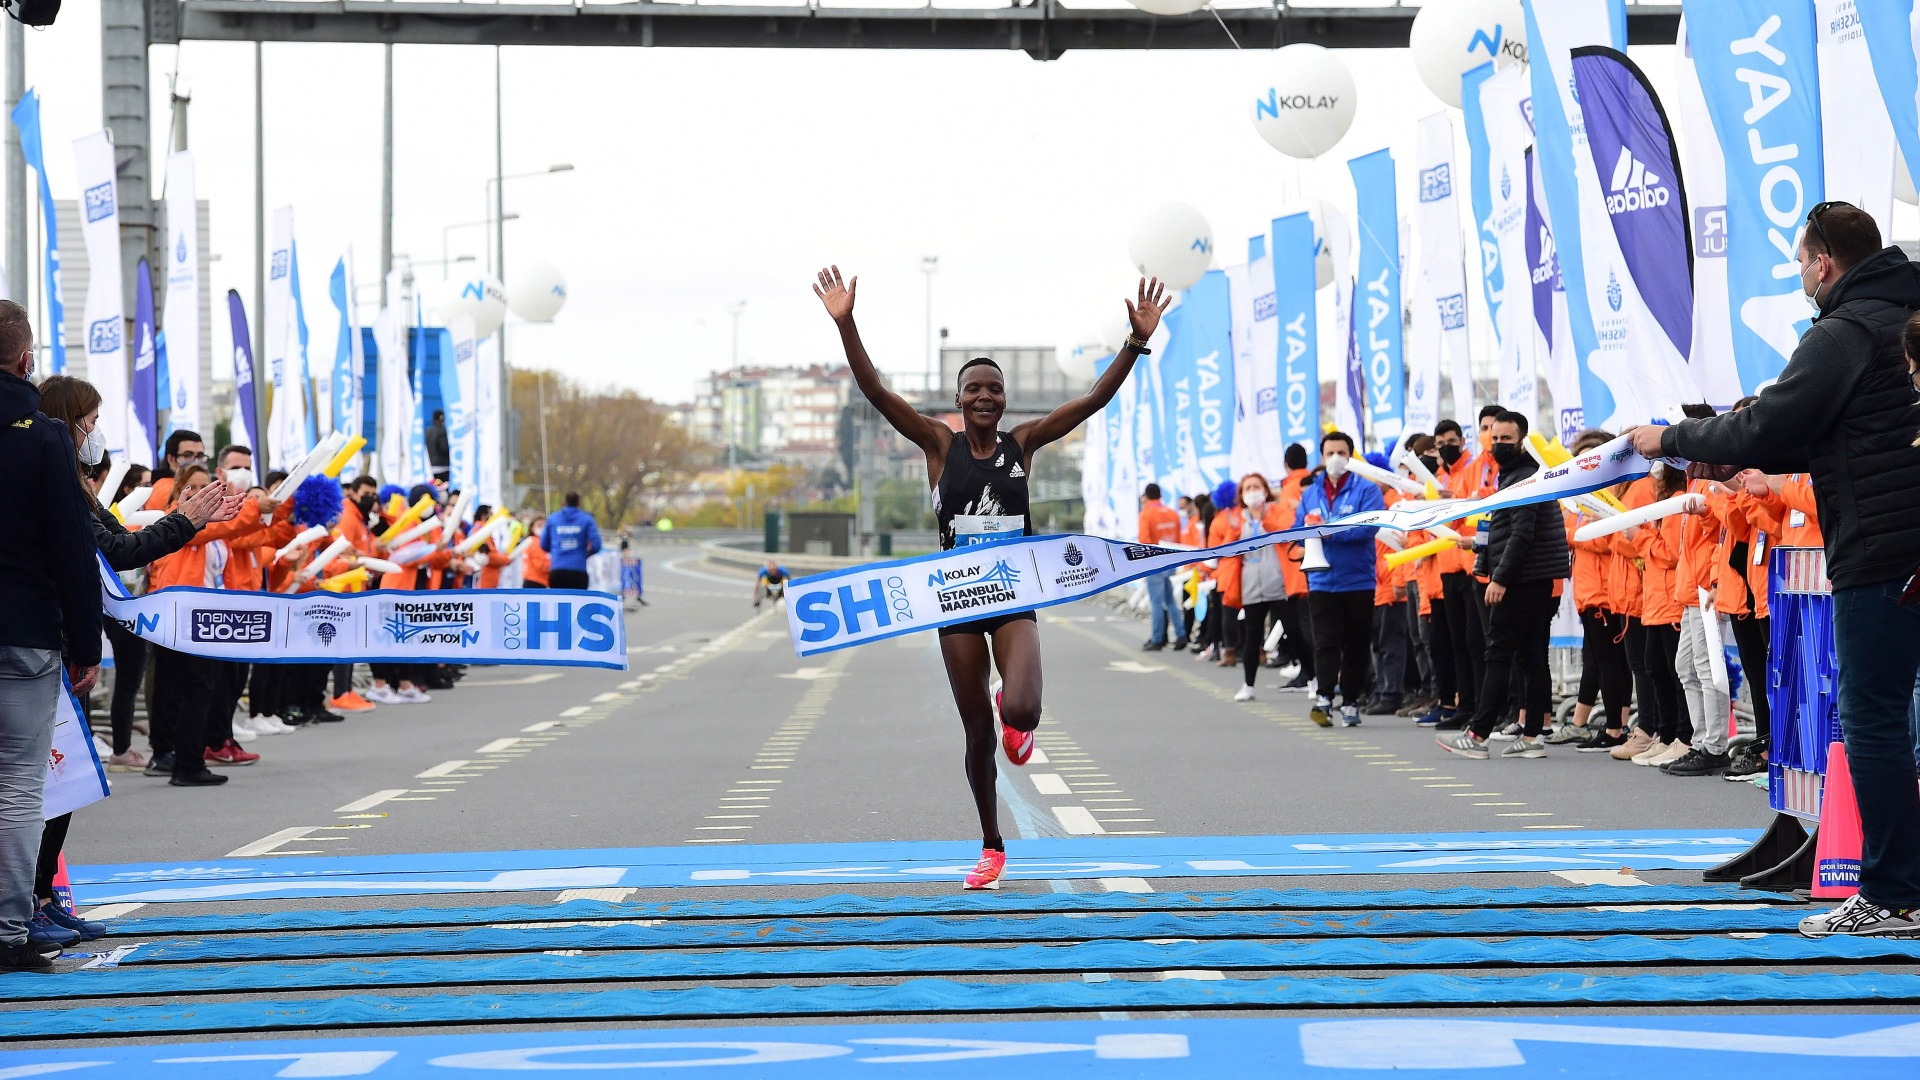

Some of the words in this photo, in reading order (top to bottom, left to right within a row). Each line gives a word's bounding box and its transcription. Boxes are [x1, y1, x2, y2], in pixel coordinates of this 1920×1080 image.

[1280, 95, 1339, 110] KOLAY
[945, 565, 981, 580] KOLAY
[937, 584, 1005, 603] İSTANBUL
[940, 590, 1016, 613] MARATHON
[394, 602, 474, 613] MARATHON
[795, 579, 891, 642] SH
[887, 575, 913, 622] 2020
[197, 612, 267, 624] İSTANBUL
[404, 613, 474, 625] İSTANBUL
[503, 602, 521, 650] 2020
[197, 623, 267, 640] SPOR
[526, 602, 615, 653] SH
[421, 633, 461, 644] KOLAY
